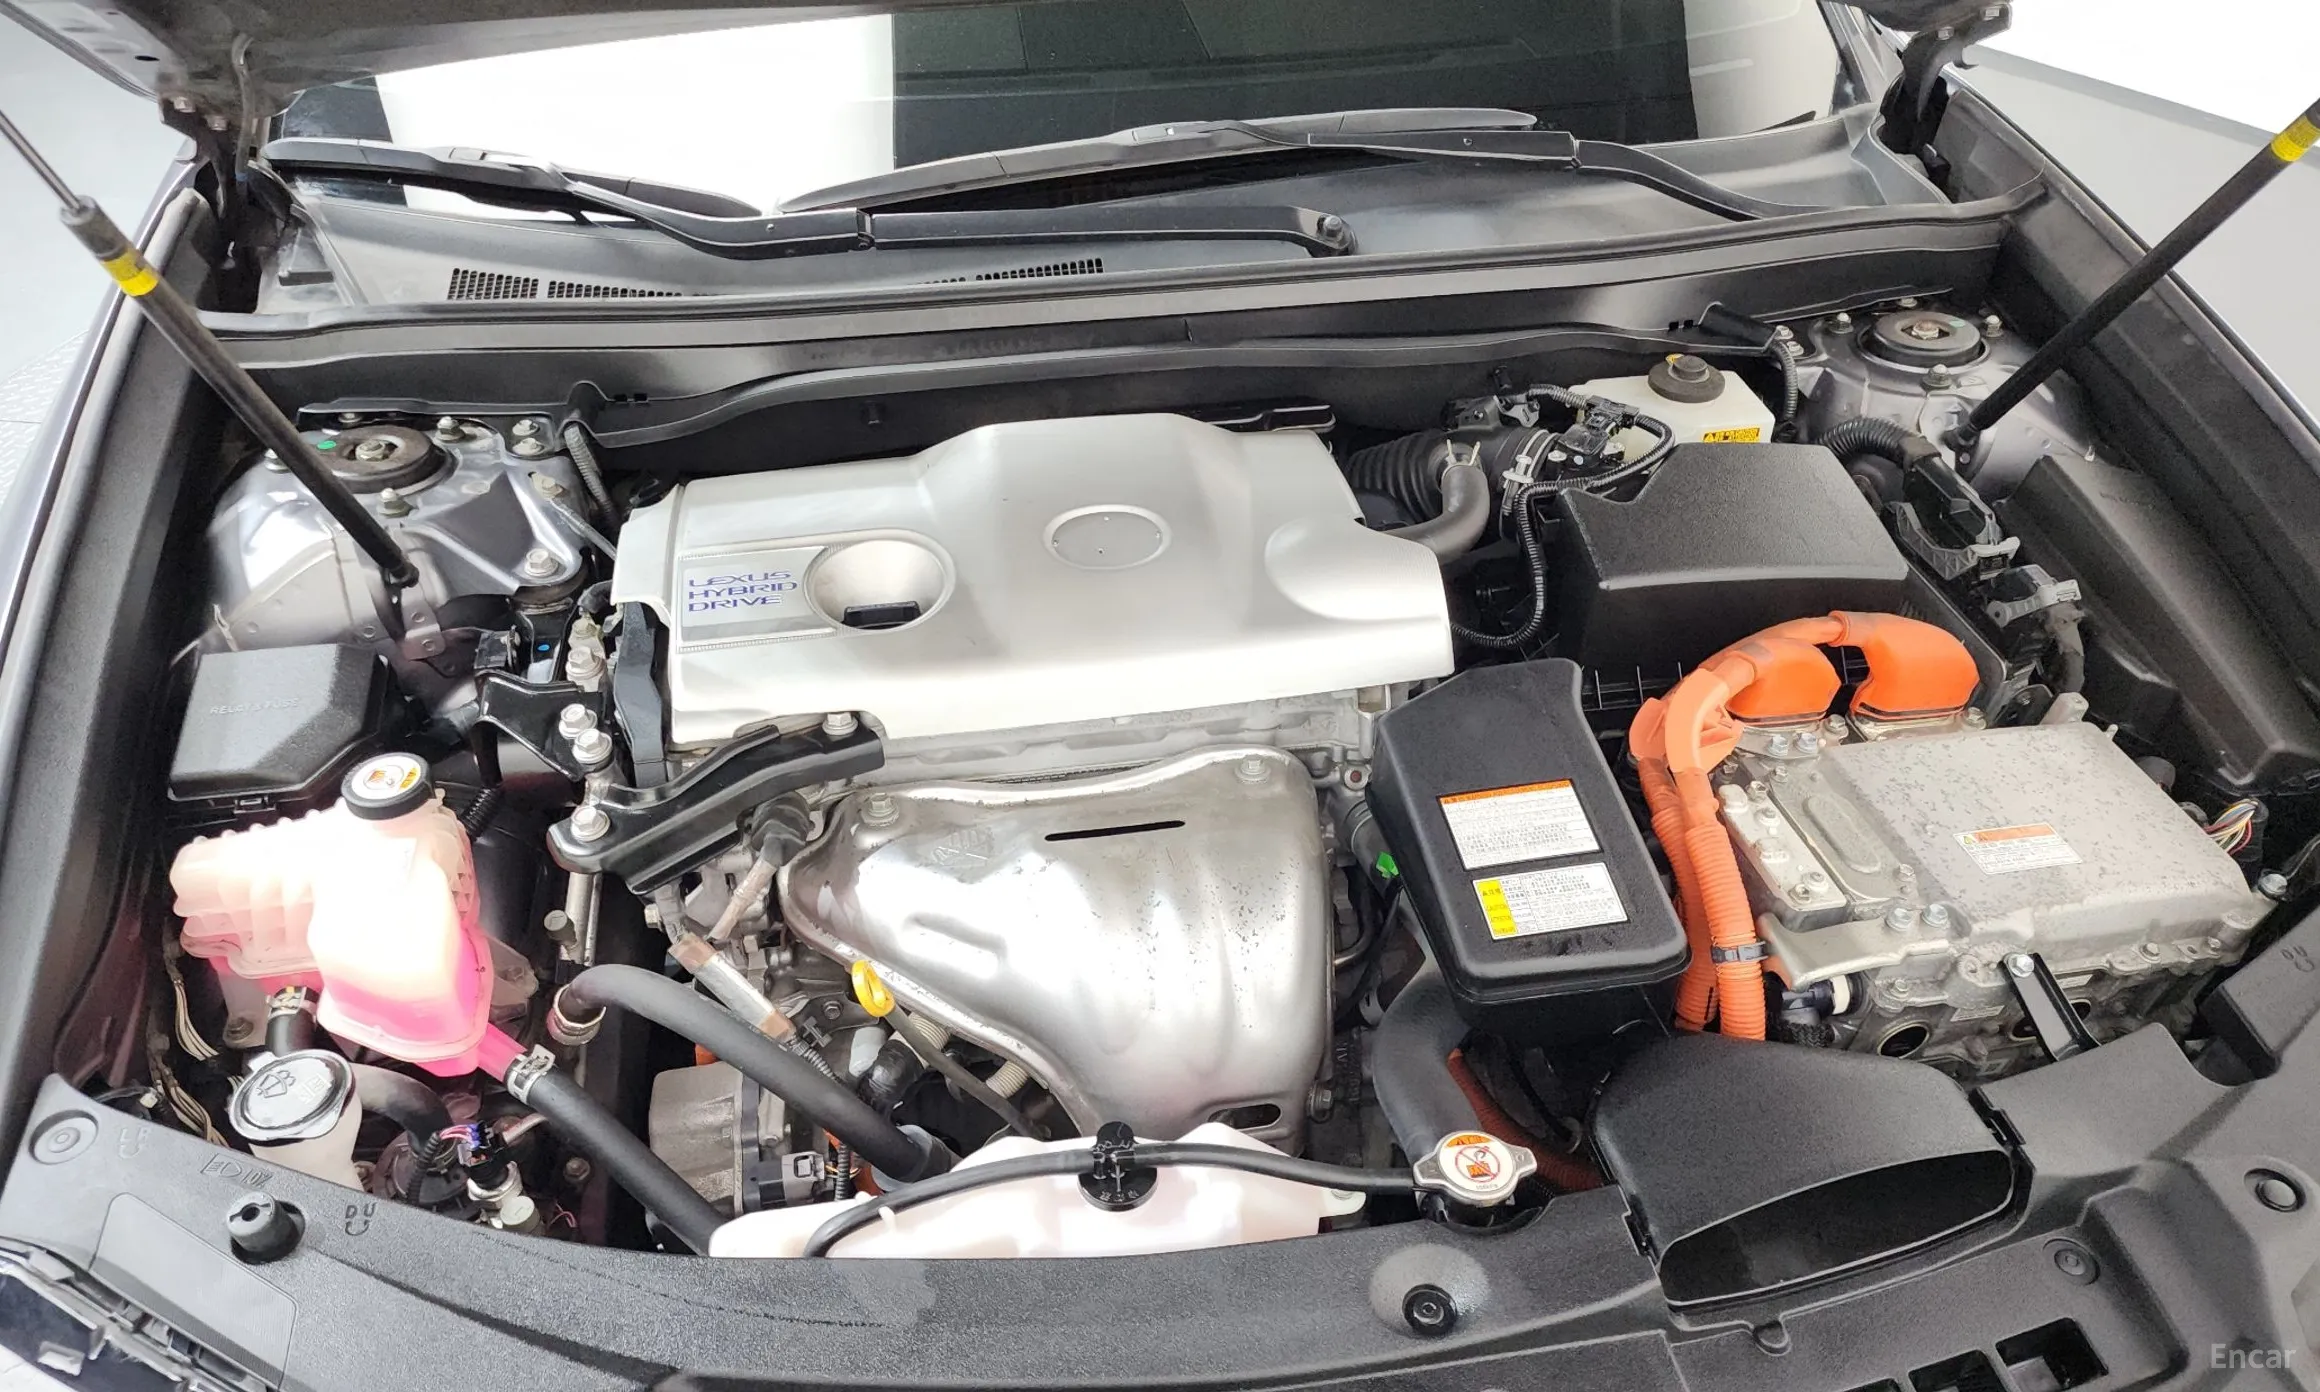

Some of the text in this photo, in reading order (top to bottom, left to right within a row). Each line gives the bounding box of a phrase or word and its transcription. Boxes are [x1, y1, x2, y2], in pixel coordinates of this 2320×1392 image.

[689, 571, 791, 587] LEXUS
[689, 582, 798, 599] HYBRID
[689, 595, 782, 612] DRIVE
